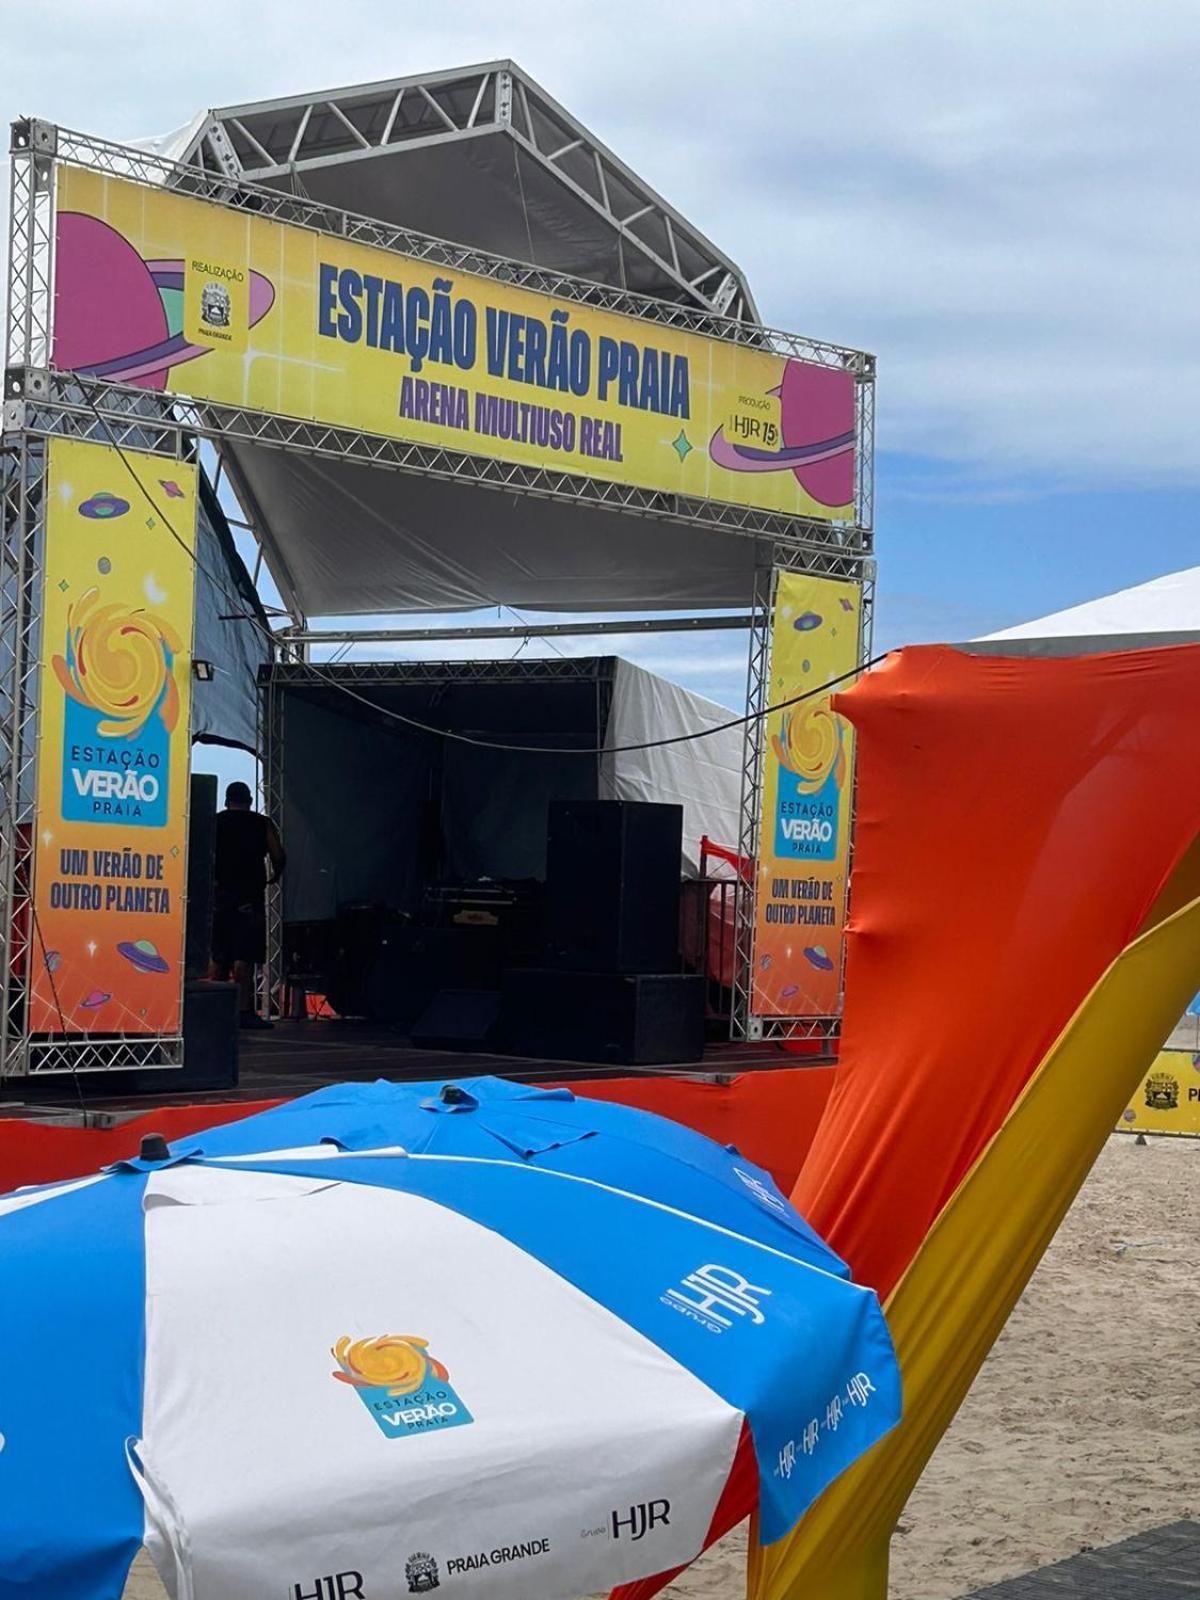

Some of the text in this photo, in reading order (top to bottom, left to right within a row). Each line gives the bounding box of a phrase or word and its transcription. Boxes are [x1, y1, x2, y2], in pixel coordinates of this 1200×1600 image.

[192, 261, 244, 282] REALIZAÇÃO
[319, 263, 690, 420] ESTAÇÃO VERÃO PRAIA
[399, 375, 623, 463] ARENA MULTIUSO REAL
[735, 415, 760, 439] HJR
[71, 745, 160, 769] ESTAÇÃO
[71, 768, 160, 802] VERÃO
[93, 802, 142, 817] PRAIA
[781, 801, 834, 818] ESTAÇÃO
[781, 818, 833, 842] VERÃO
[792, 842, 822, 854] PRAIA
[60, 847, 164, 880] UM VERÃO DE
[51, 882, 170, 914] OUTRO PLANETA
[772, 877, 833, 900] UM VERÃO DE
[766, 903, 836, 926] OUTRO PLANETA
[374, 1391, 447, 1411] ESTAÇÃO
[847, 1372, 877, 1407] HJR
[382, 1402, 457, 1426] VERÃO
[406, 1416, 449, 1430] PRAIA
[612, 1499, 671, 1541] HJR
[446, 1538, 551, 1576] PRAIA GRANDE
